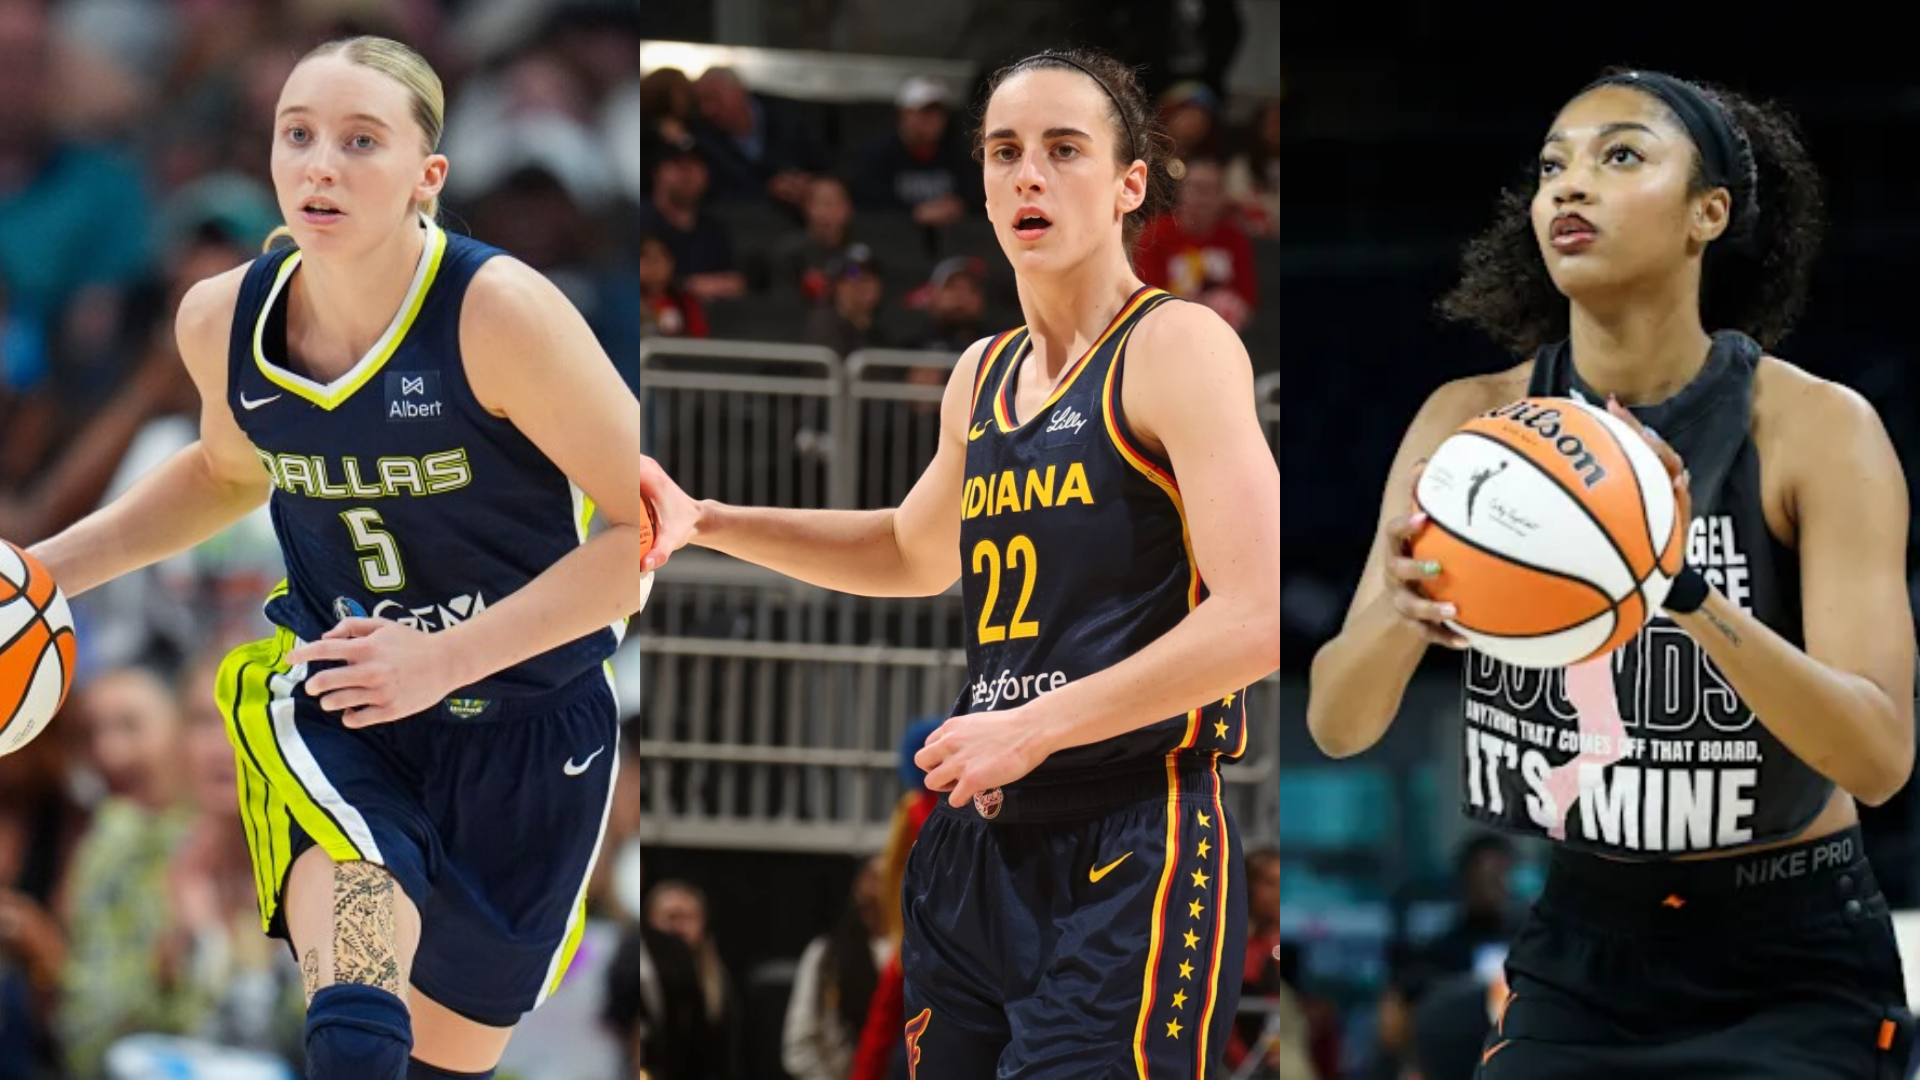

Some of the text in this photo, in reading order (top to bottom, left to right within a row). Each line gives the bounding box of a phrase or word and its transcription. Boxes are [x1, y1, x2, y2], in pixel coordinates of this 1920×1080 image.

[389, 399, 443, 419] Albert
[1045, 405, 1088, 436] Lilly
[1478, 400, 1607, 488] ilson
[961, 461, 1095, 521] NDIANA
[338, 506, 406, 593] 5
[1685, 514, 1748, 568] GEL
[972, 534, 1040, 646] 22
[1519, 719, 1556, 749] THAT
[1557, 728, 1612, 755] COMES
[1650, 739, 1695, 763] THAT
[1698, 740, 1764, 764] BOARD.
[1465, 726, 1758, 851] IT'S MINE
[1735, 838, 1854, 888] NIKE PRO
